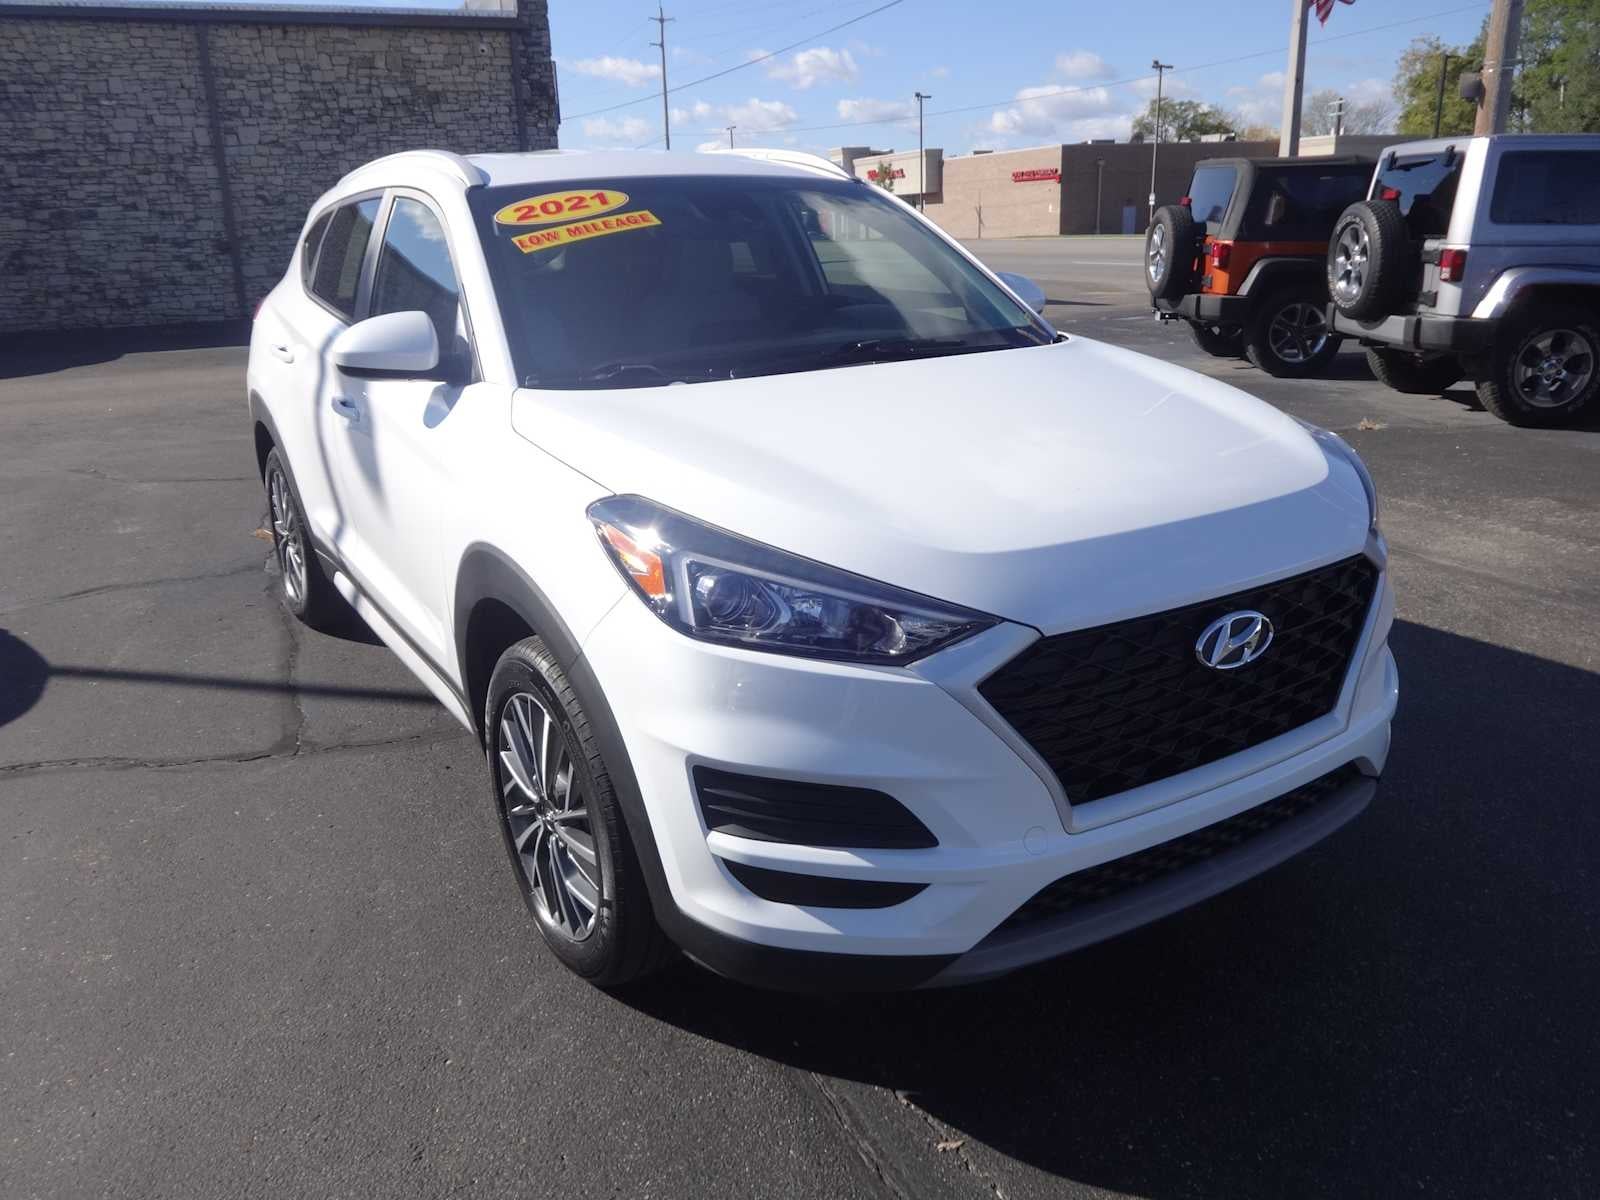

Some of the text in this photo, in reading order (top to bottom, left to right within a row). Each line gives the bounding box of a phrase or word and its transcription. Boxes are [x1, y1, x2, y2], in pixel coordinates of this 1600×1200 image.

[513, 192, 610, 222] 2021
[517, 212, 653, 249] LOW MILEAGE
